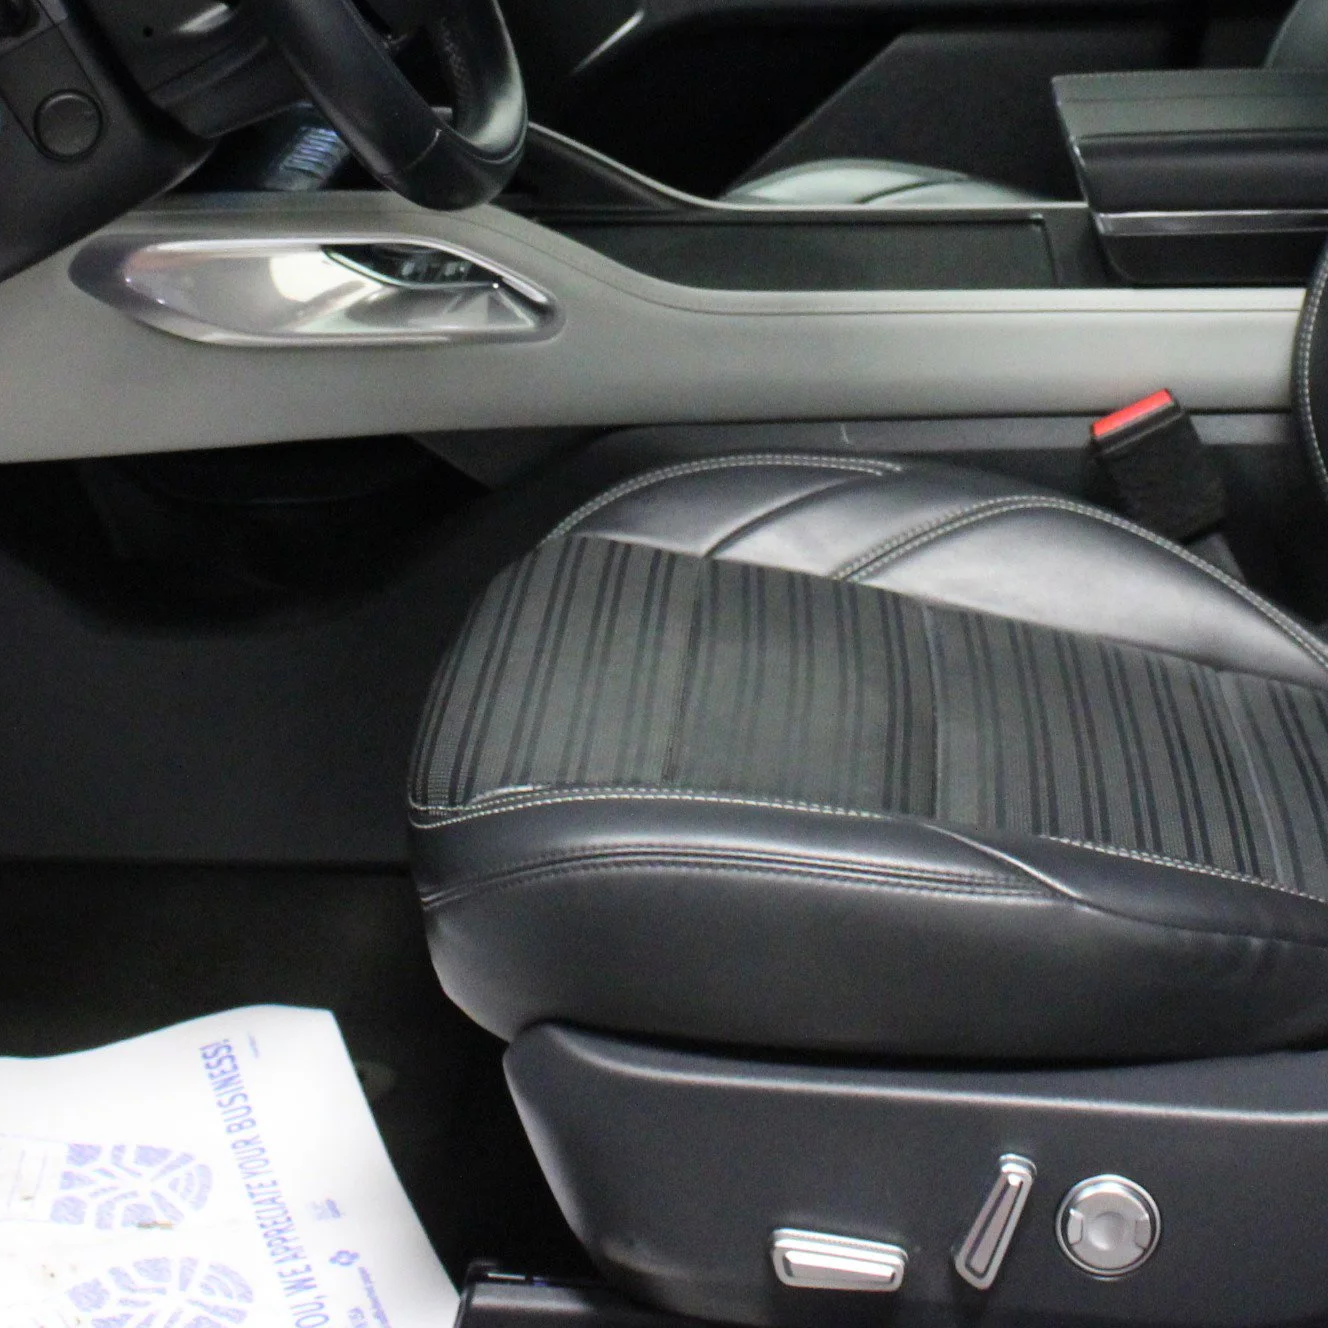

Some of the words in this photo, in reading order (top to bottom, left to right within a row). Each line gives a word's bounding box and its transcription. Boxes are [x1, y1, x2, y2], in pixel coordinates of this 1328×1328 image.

[199, 1038, 257, 1134] BUSINESS!
[230, 1133, 275, 1180] YOUR
[245, 1179, 308, 1264] APPRECIATE
[277, 1264, 318, 1297] WE
[289, 1295, 330, 1328] OU,
